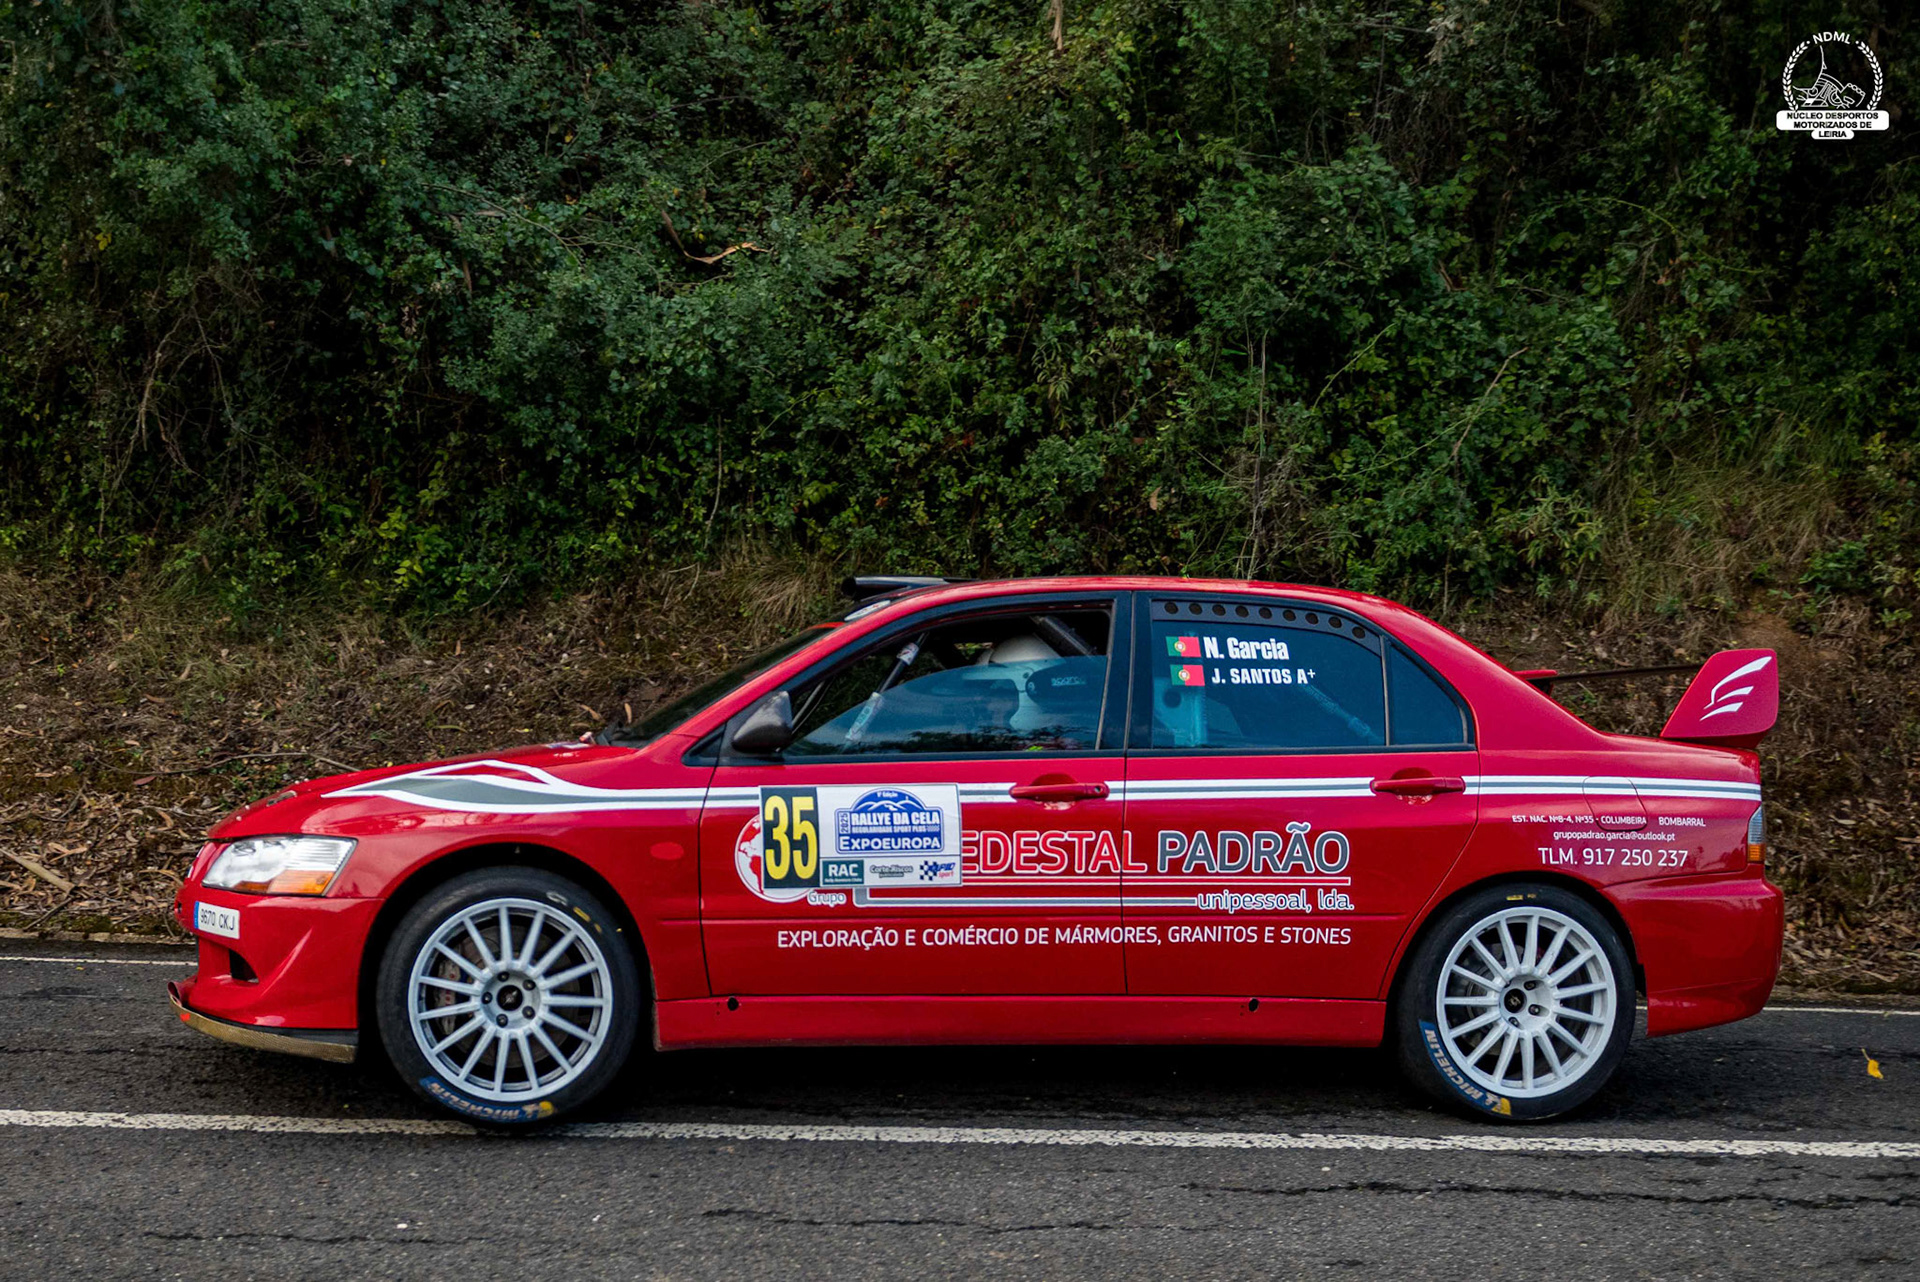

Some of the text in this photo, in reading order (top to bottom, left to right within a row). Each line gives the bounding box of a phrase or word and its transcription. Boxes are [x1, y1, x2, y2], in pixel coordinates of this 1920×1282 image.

[1203, 636, 1290, 660] N. Garcia
[1211, 668, 1226, 684] J.
[1230, 668, 1292, 685] SANTOS
[840, 813, 848, 833] 2025
[851, 811, 940, 826] RALLYE DA CELA
[1600, 815, 1647, 825] COLUMBEIRA
[1658, 816, 1706, 827] BOMBARRAL
[764, 794, 818, 881] 35
[1553, 829, 1676, 843] grupopadrao.garcia@outlook.pt
[1157, 821, 1350, 874] PADRÃO
[1538, 847, 1689, 868] TLM. 917 250 237
[828, 863, 859, 877] RAC
[807, 890, 847, 907] Grupo
[1198, 888, 1355, 914] unipessoal, lda.
[219, 913, 236, 930] CKJ
[777, 924, 1352, 950] EXPLORAÇÃO E COMÉRCIO DE MÁRMORES, GRANITOS E STONES
[1424, 1029, 1484, 1100] MICHELIN
[428, 1082, 520, 1120] MICHELIN
